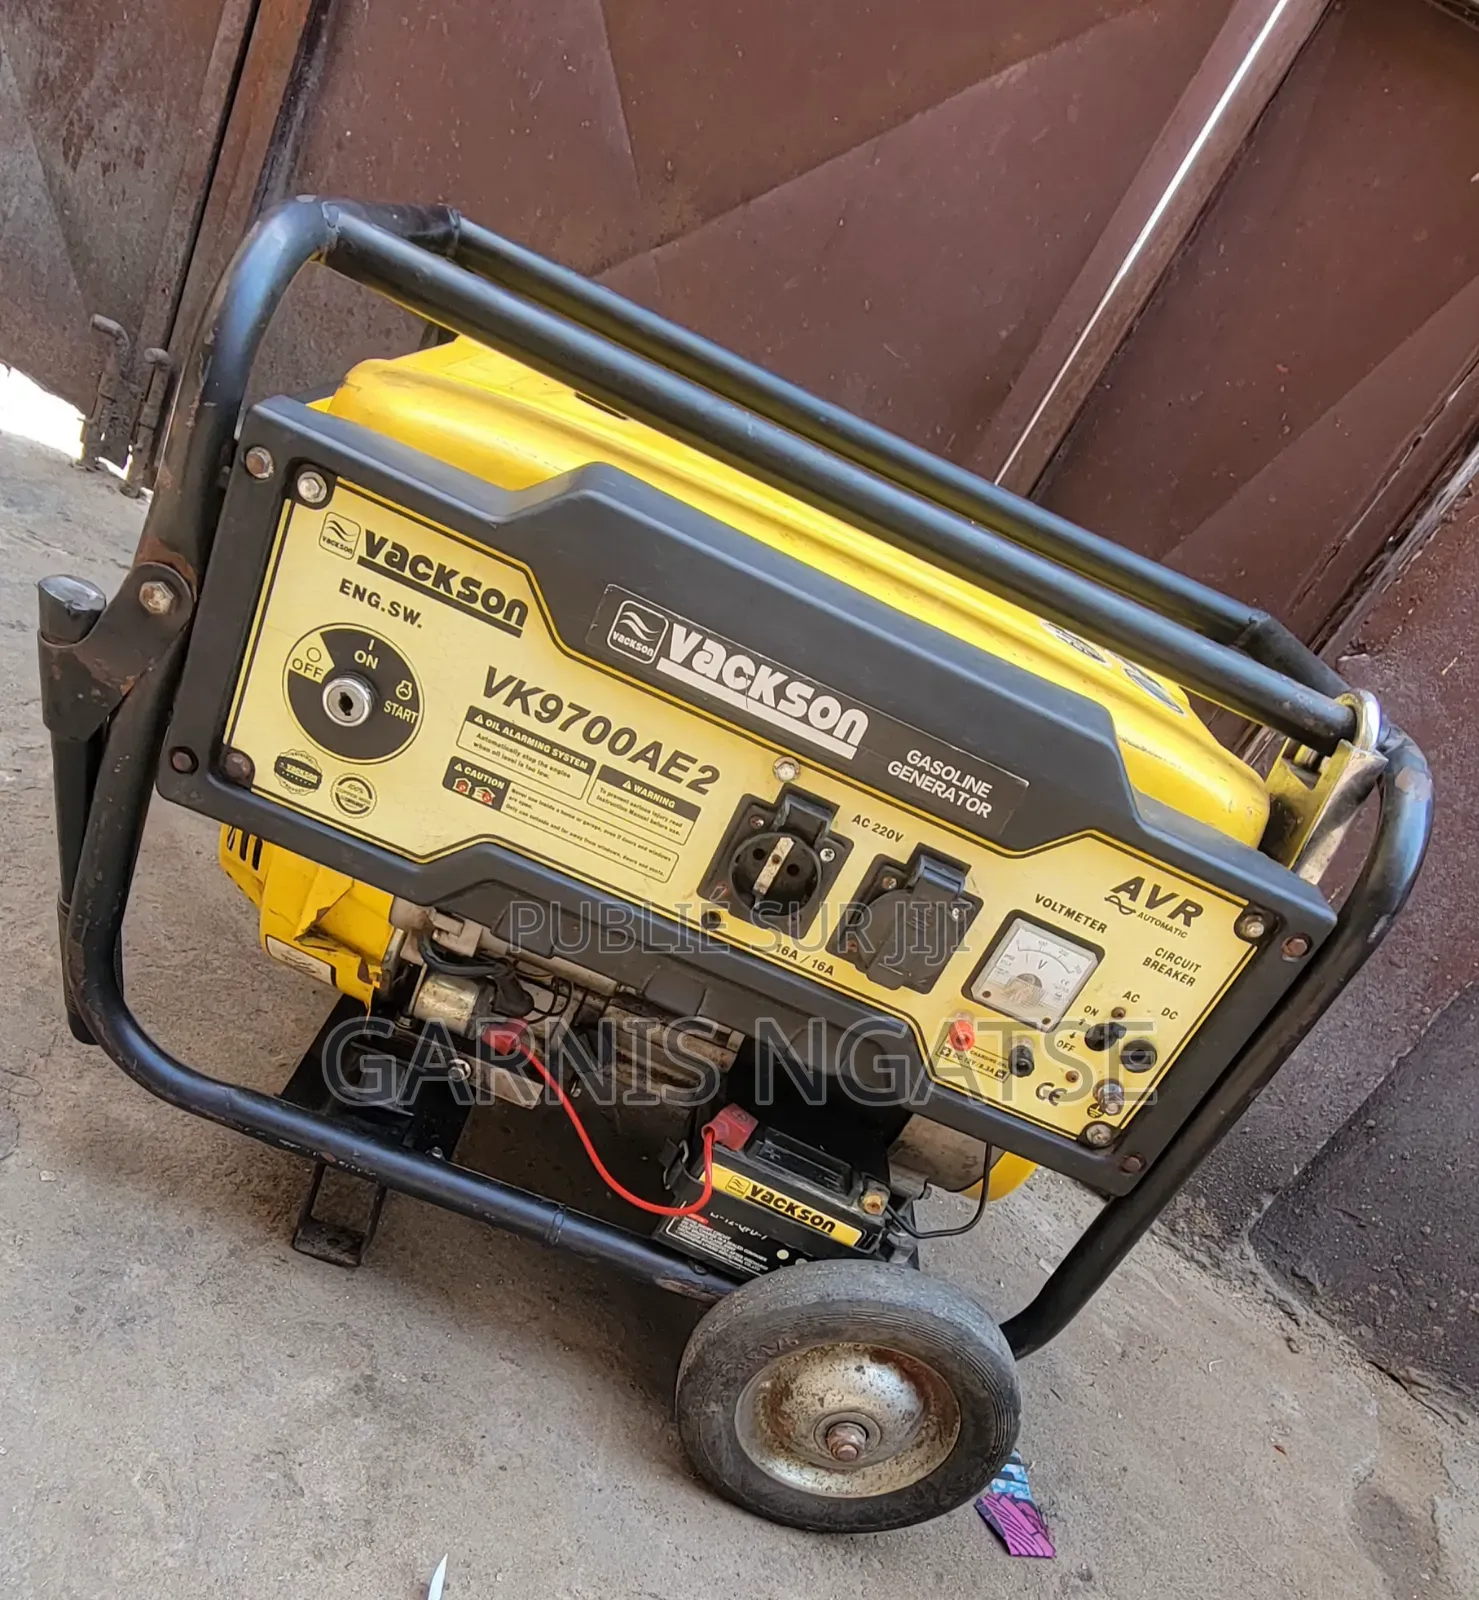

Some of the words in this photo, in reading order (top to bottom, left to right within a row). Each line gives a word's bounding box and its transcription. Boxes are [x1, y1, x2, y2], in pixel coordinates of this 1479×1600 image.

[338, 577, 422, 629] ENG.SW.
[292, 658, 324, 679] OFF
[354, 650, 379, 669] ON
[383, 700, 419, 724] START
[483, 665, 721, 796] VK9700AE2
[484, 718, 502, 731] OIL
[501, 726, 551, 753] ALARMING
[550, 748, 588, 770] SYSTEM
[472, 741, 491, 753] when
[500, 753, 517, 764] level
[524, 764, 536, 772] too
[475, 732, 521, 757] Automatically
[521, 752, 537, 763] stop
[537, 759, 548, 768] the
[548, 765, 571, 779] engine
[463, 766, 505, 789] CAUTION
[887, 760, 993, 819] GENERATOR
[906, 750, 993, 799] GASOLINE
[606, 791, 629, 805] prevent
[629, 801, 651, 814] serious
[651, 810, 668, 822] injury
[669, 818, 682, 827] read
[632, 784, 676, 808] WARNING
[649, 818, 668, 829] before
[851, 813, 871, 829] AC
[871, 822, 905, 843] 220V
[1034, 893, 1108, 934] VOLTMETER
[1110, 875, 1205, 928] AVR
[1136, 911, 1188, 939] AUTOMATIC
[775, 942, 798, 961] 16A
[811, 958, 835, 977] 16A
[1142, 957, 1197, 988] BREAKER
[1154, 947, 1202, 974] CIRCUIT
[1083, 1004, 1100, 1017] ON
[1122, 990, 1141, 1004] AC
[1160, 1007, 1179, 1021] DC
[1056, 1039, 1076, 1053] OFF
